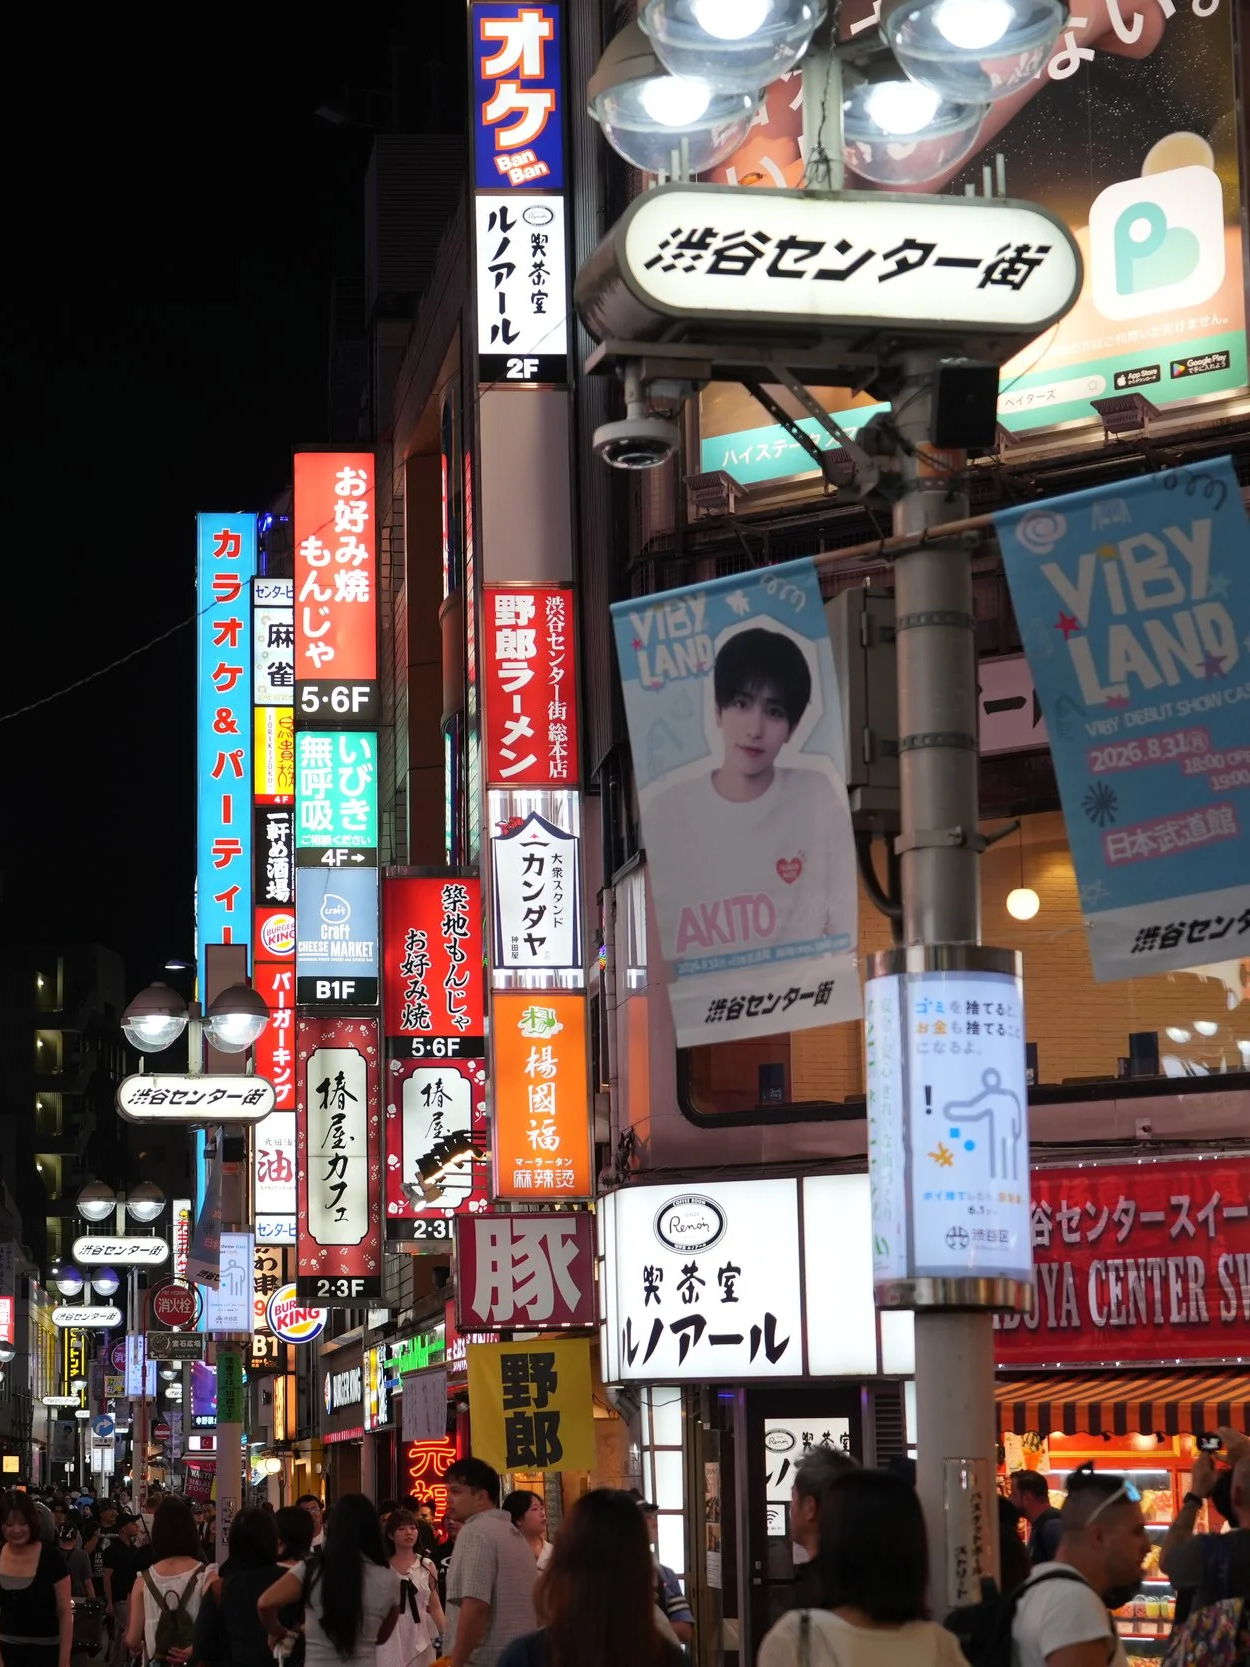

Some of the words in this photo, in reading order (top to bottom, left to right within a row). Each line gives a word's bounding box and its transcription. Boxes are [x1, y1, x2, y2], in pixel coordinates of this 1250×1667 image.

[495, 150, 536, 173] Ban
[510, 161, 550, 186] Ban
[488, 205, 520, 346] ルノアール
[529, 232, 551, 315] 喫茶室
[643, 226, 1052, 292] 渋谷センター街
[506, 359, 539, 379] 2F
[334, 467, 370, 603] お好み焼
[299, 537, 335, 669] もんじゃ
[545, 596, 568, 721] 渋谷センター街
[1067, 602, 1241, 706] LAND
[494, 594, 537, 780] 野郎ラーメン
[1124, 705, 1175, 728] DEBUT
[547, 724, 568, 780] 総本店
[274, 796, 288, 804] 4F
[299, 737, 334, 832] 無呼吸
[338, 737, 371, 832] いびき
[321, 848, 349, 867] 4F
[1105, 805, 1237, 863] 日本武道館
[551, 853, 563, 928] 大衆スタンド
[298, 941, 329, 953] CHEESE
[330, 941, 374, 957] MARKET
[320, 924, 350, 940] Craft
[676, 892, 777, 955] AKITO
[401, 930, 432, 1031] お好み焼
[441, 885, 470, 1032] 築地もんじゃ
[316, 980, 356, 1000] B1F
[705, 980, 835, 1024] 渋谷センター街
[272, 972, 292, 1102] バーガーキング
[126, 1087, 263, 1107] 渋谷センター街
[316, 1071, 358, 1224] 椿屋カフェ
[514, 1157, 573, 1167] マーラータン
[78, 1244, 165, 1258] 渋谷センター街
[471, 1218, 581, 1323] 豚
[158, 1297, 191, 1313] 消火栓
[643, 1260, 741, 1308] 喫茶室
[1087, 1254, 1210, 1328] CENTER
[277, 1308, 320, 1332] KING
[622, 1311, 791, 1369] ルノアール
[500, 1352, 563, 1469] 野郎
